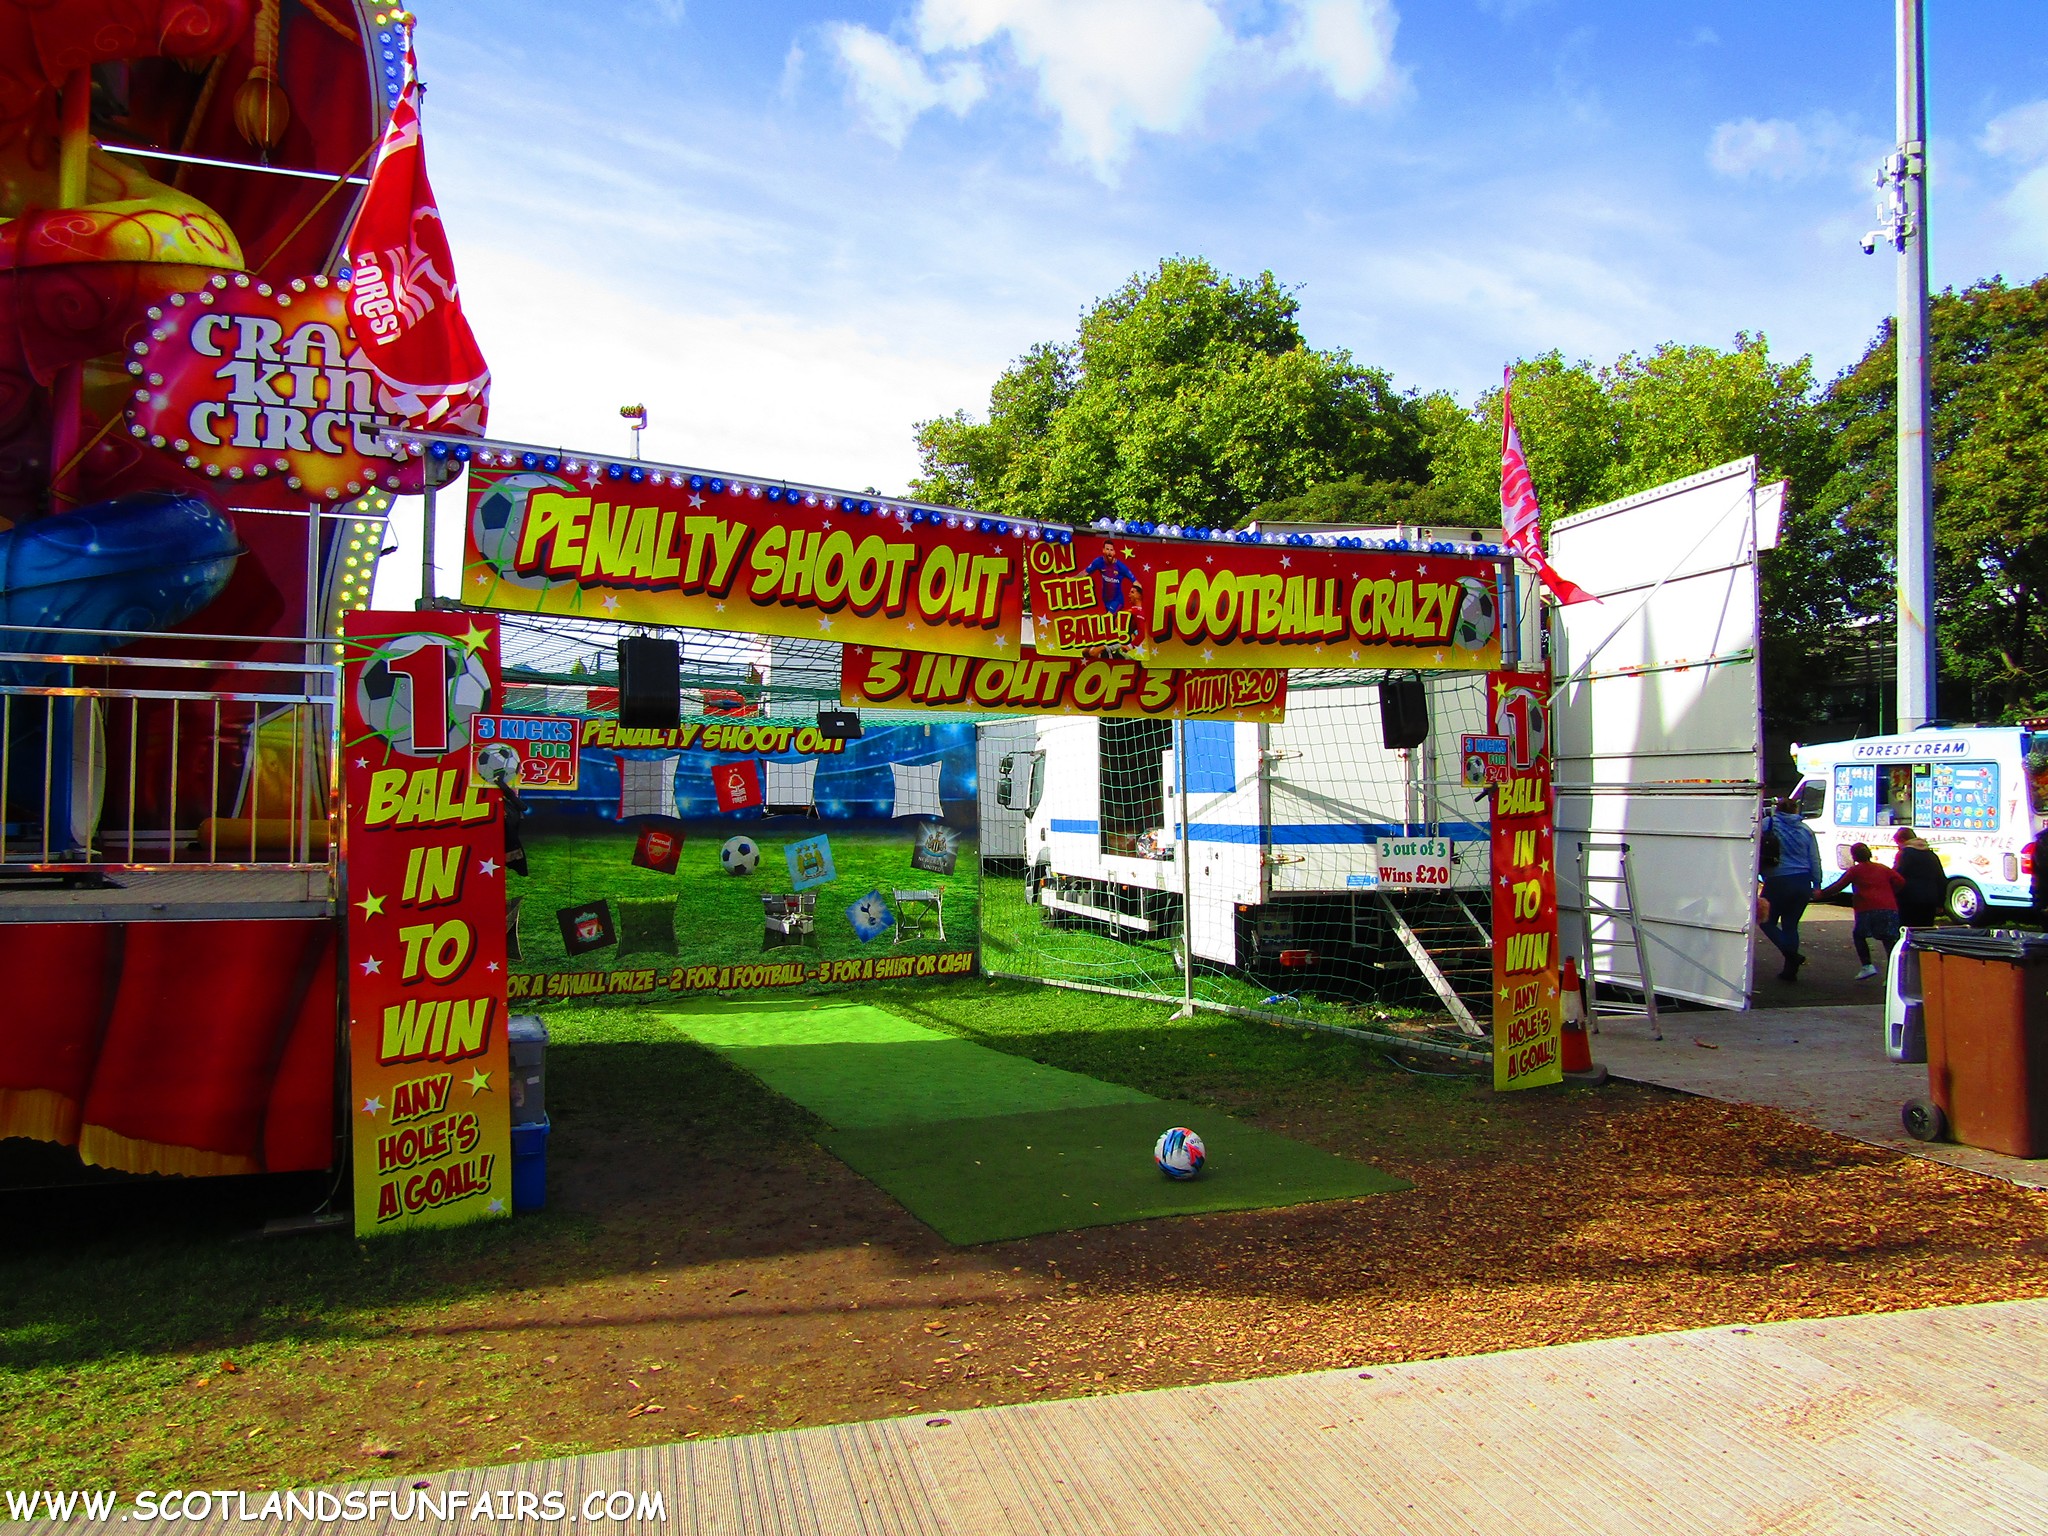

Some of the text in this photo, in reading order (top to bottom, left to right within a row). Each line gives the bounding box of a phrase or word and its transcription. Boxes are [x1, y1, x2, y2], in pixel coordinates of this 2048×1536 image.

[190, 314, 375, 369] CRA
[520, 493, 1009, 620] PENALTY SHOOT OUT
[1030, 541, 1075, 574] ON
[1040, 576, 1096, 611] THE
[1151, 569, 1460, 639] FOOTBALL CRAZY
[1054, 611, 1131, 649] BALL!
[387, 643, 447, 750] 1
[864, 651, 1173, 706] 3 IN OUT OF 3
[1184, 669, 1279, 715] WIN £20
[478, 718, 573, 742] 3 KICKS
[529, 743, 570, 758] FOR
[702, 726, 793, 751] SHOOT
[1465, 738, 1507, 753] 3 KICKS
[1505, 694, 1530, 767] 1
[1858, 742, 1965, 756] FOREST CREAM
[520, 760, 574, 785] £4
[1484, 766, 1510, 784] £4
[1488, 754, 1506, 765] FOR
[365, 768, 490, 825] BALL
[1497, 777, 1545, 815] BALL
[922, 864, 942, 873] UNITED
[1382, 840, 1446, 858] 3 out of 3
[1513, 830, 1536, 867] IN
[402, 845, 463, 903] IN
[1379, 866, 1413, 884] Wins
[1416, 864, 1449, 885] £20
[1512, 878, 1541, 919] TO
[399, 919, 470, 980] TO
[1505, 932, 1549, 973] WIN
[507, 976, 528, 998] OR
[531, 974, 545, 996] A
[608, 970, 656, 993] PRIZE
[669, 968, 684, 991] 2
[685, 966, 718, 989] FOR
[719, 967, 731, 988] A
[732, 964, 803, 987] FOOTBALL
[819, 962, 831, 983] 3
[832, 960, 860, 982] FOR
[862, 959, 873, 979] A
[876, 957, 917, 977] SHIRT
[916, 955, 936, 975] OR
[937, 952, 972, 973] CASH
[1513, 981, 1539, 1016] ANY
[381, 997, 489, 1060] WIN
[1507, 1008, 1551, 1050] HOLE'S
[1507, 1036, 1558, 1082] A GOAL!
[390, 1073, 454, 1125] ANY
[376, 1112, 480, 1175] HOLE'S
[377, 1154, 495, 1223] A GOAL!
